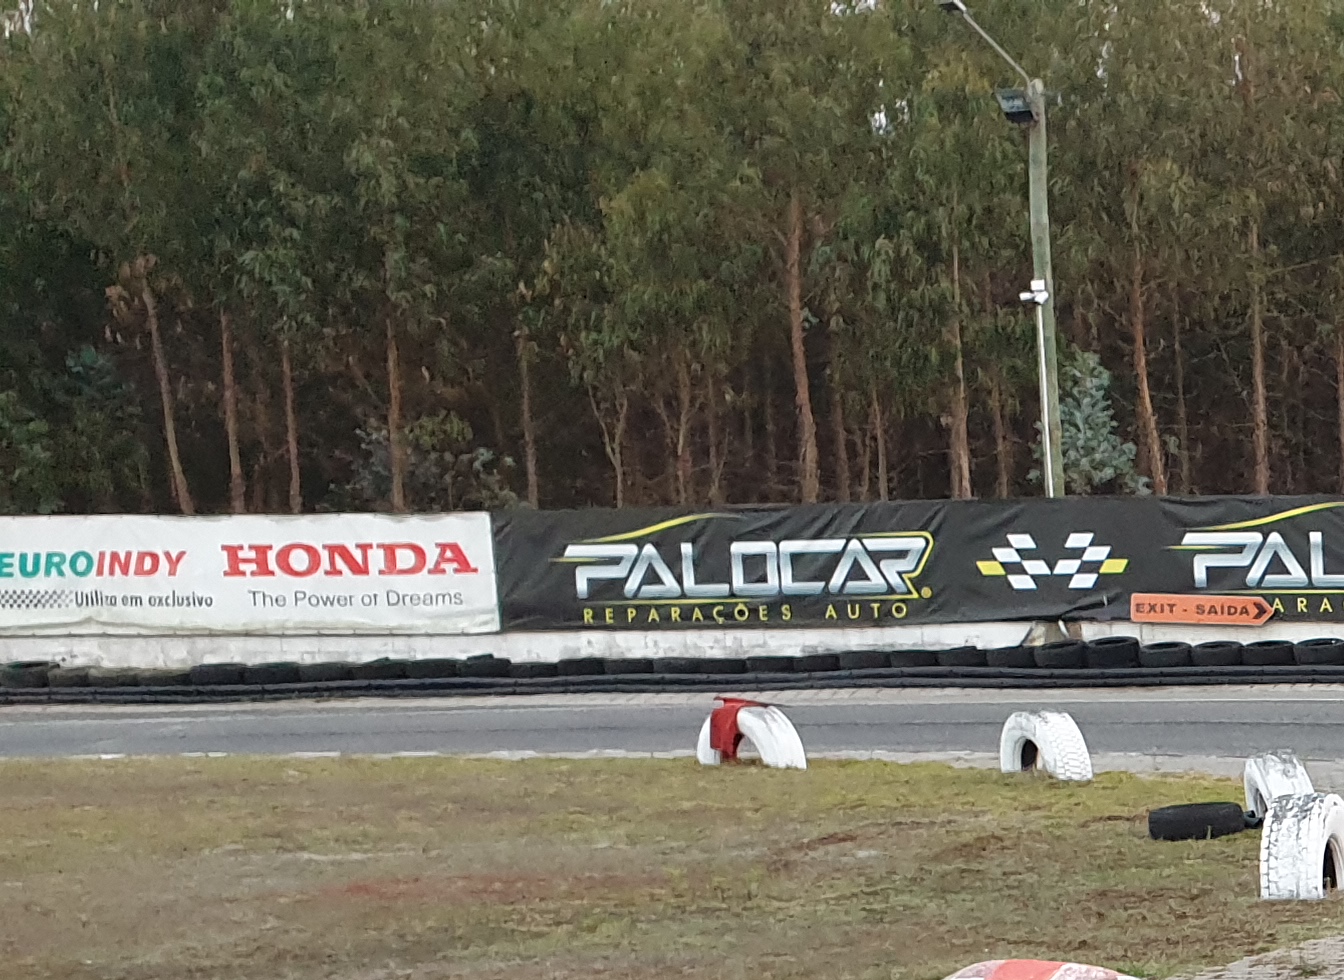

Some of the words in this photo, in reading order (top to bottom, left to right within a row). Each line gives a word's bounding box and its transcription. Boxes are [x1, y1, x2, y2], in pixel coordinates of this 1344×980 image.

[0, 550, 187, 578] EUROINDY
[221, 542, 478, 577] HONDA
[564, 537, 928, 600] PALOCAR
[248, 590, 287, 607] The
[294, 590, 351, 607] Power
[361, 592, 378, 607] of
[386, 589, 463, 607] Dreams
[1135, 603, 1177, 614] EXIT
[1195, 603, 1250, 616] SAÍDA
[583, 602, 793, 624] REPARAÇÕES
[825, 602, 907, 620] AUTO
